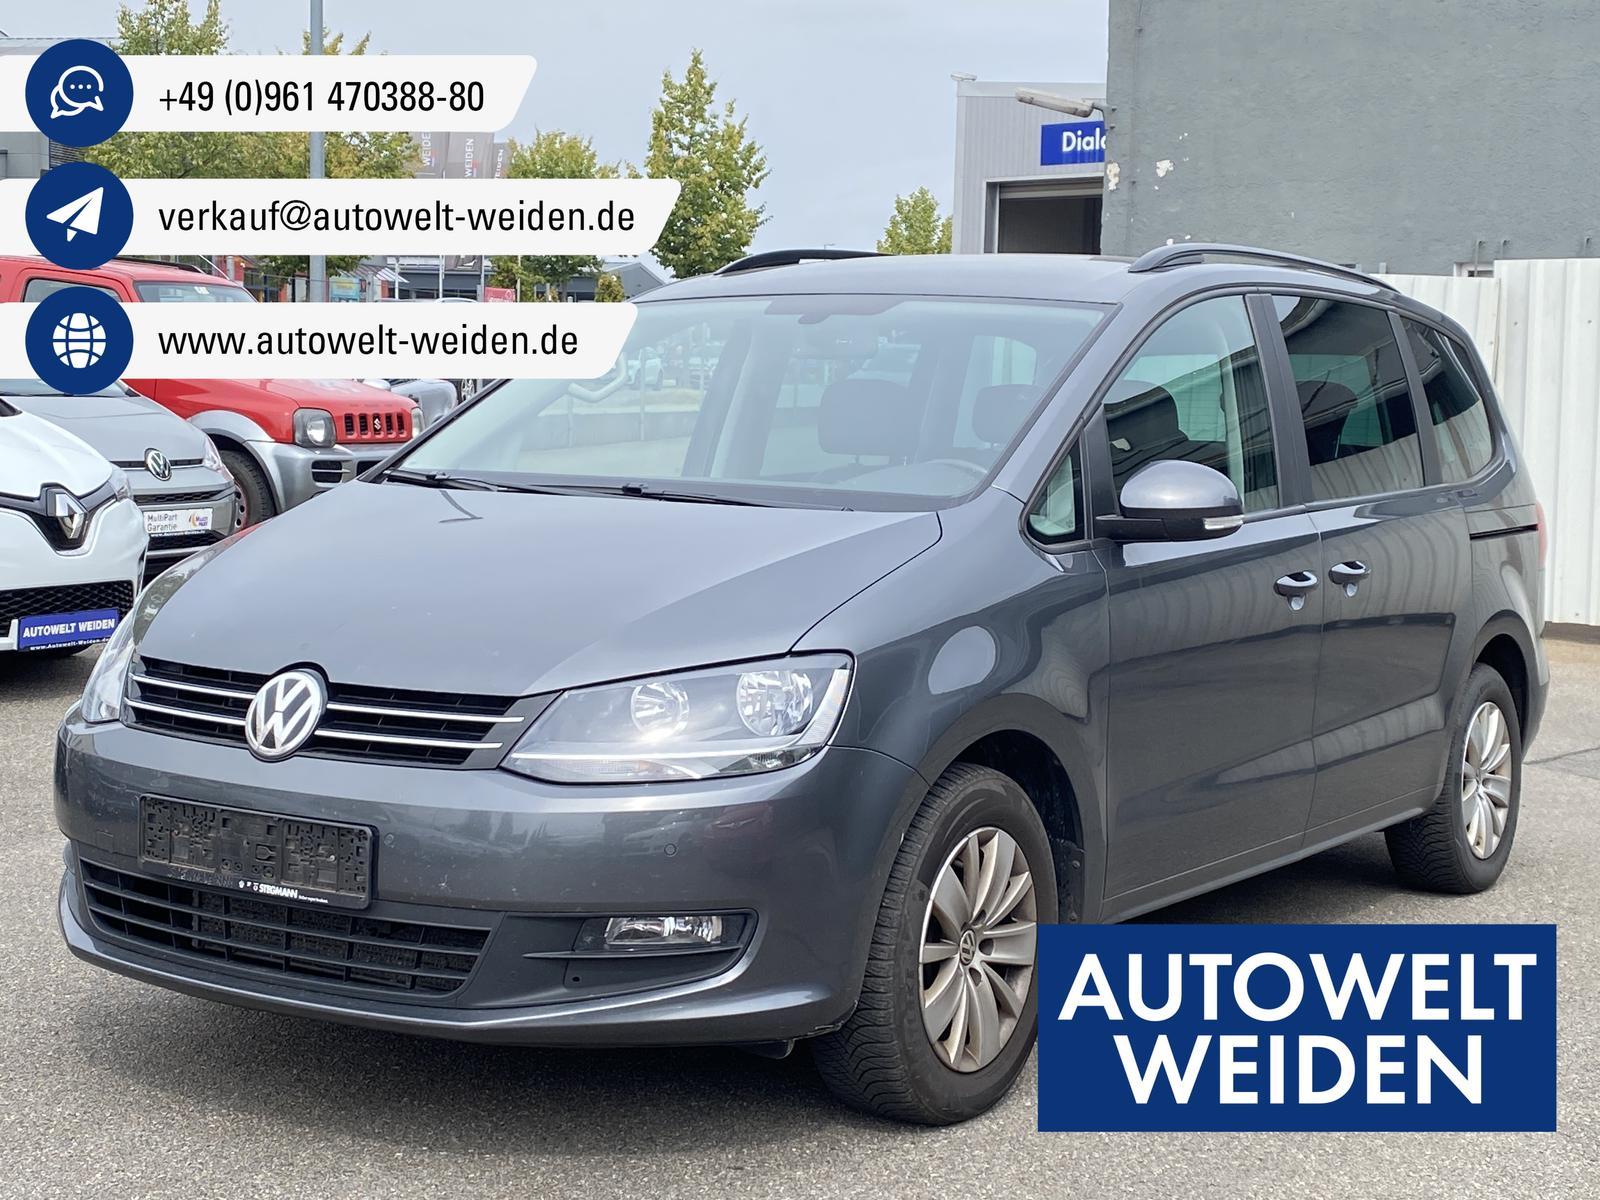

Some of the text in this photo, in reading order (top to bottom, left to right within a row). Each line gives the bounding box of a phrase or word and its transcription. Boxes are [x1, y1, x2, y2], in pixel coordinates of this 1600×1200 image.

[464, 138, 474, 178] WEIDEN
[495, 148, 504, 178] EIDEN
[147, 522, 178, 532] Garantie
[23, 618, 116, 638] AUTOWELT WEIDEN
[259, 883, 299, 899] STEGMANN
